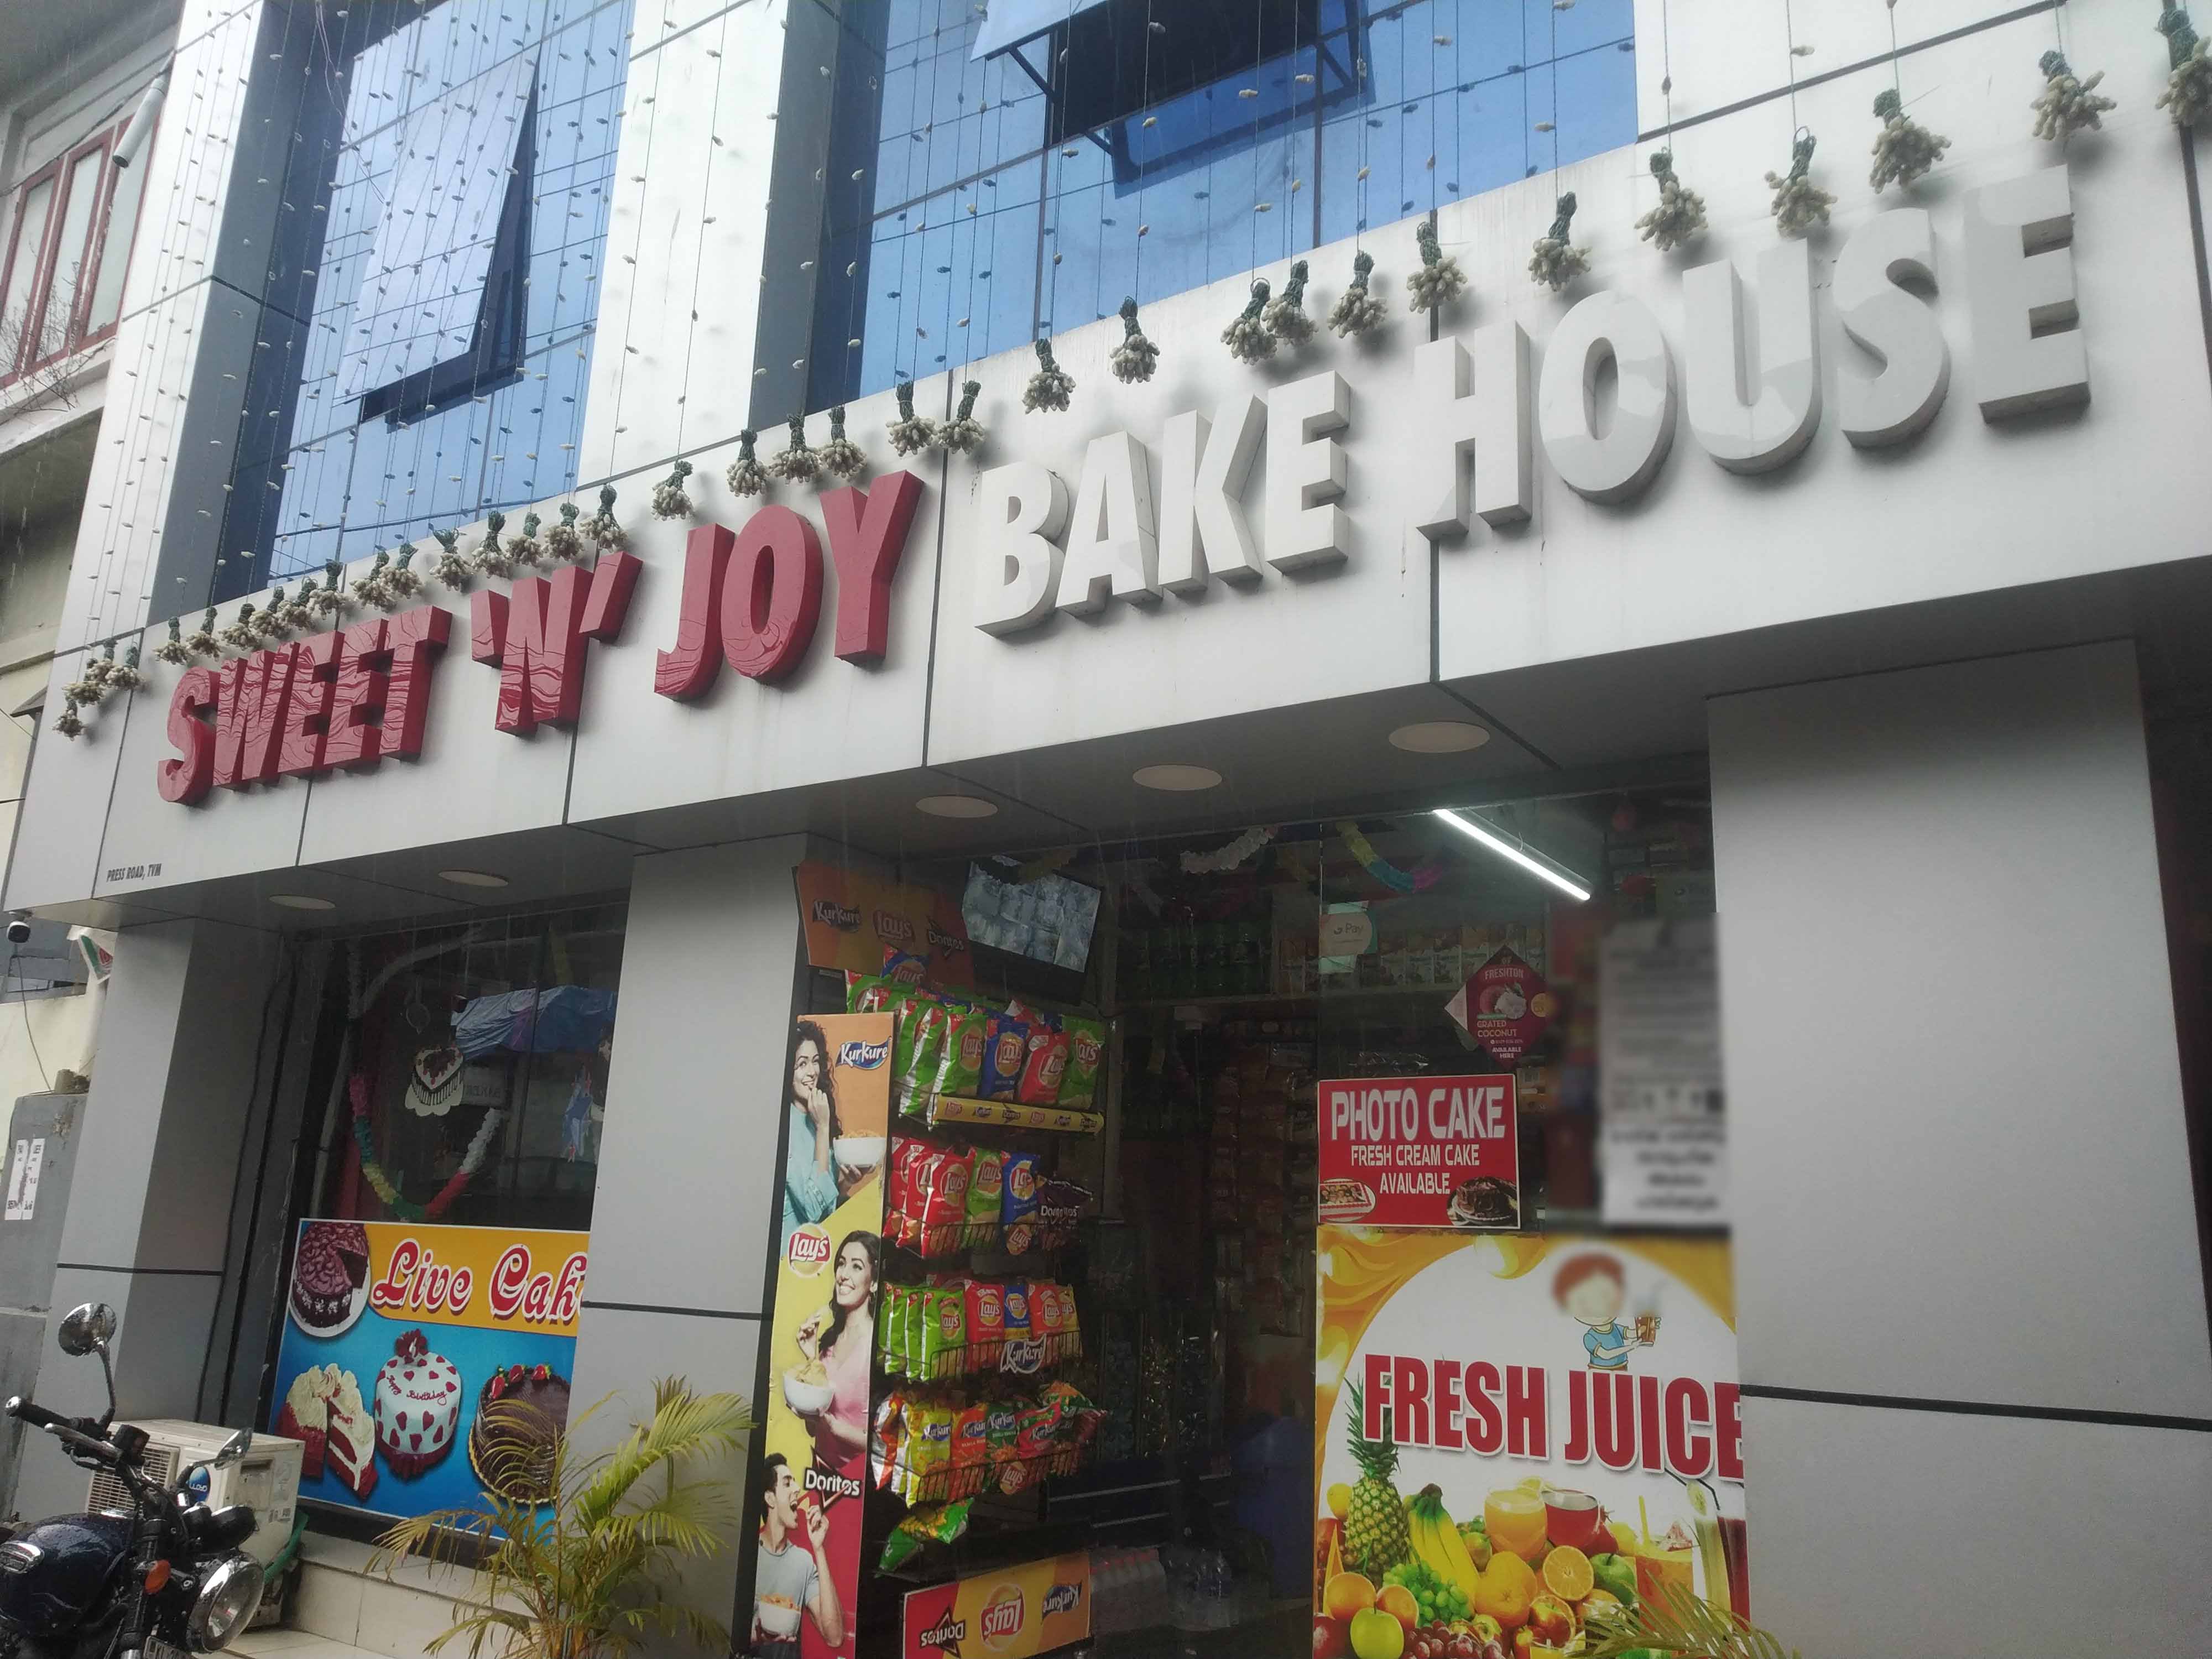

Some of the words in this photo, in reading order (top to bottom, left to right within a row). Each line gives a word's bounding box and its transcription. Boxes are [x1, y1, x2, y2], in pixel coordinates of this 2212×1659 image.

[158, 606, 452, 806] SWEET
[654, 471, 925, 702] JOY
[974, 370, 1351, 638] BAKE
[1414, 164, 2091, 542] HOUSE
[106, 867, 126, 883] PRESS
[126, 865, 145, 880] ROAD,
[1477, 1029, 1518, 1037] COCONUT
[840, 1039, 889, 1067] Kurkure
[1331, 1088, 1419, 1142] PHOTO
[1427, 1087, 1506, 1140] CAKE
[1351, 1145, 1393, 1167] FRESH
[1395, 1144, 1442, 1167] CREAM
[1444, 1144, 1480, 1166] CAKE
[1380, 1171, 1451, 1196] AVAILABLE
[371, 1238, 473, 1313] Live
[488, 1242, 588, 1322] Cak
[406, 1390, 447, 1406] Birthday
[1364, 1353, 1550, 1461] FRESH
[1564, 1369, 1744, 1483] JUICE
[806, 1470, 860, 1496] Doritos
[1043, 1584, 1079, 1615] Kurkure
[921, 1621, 964, 1647] Doritos
